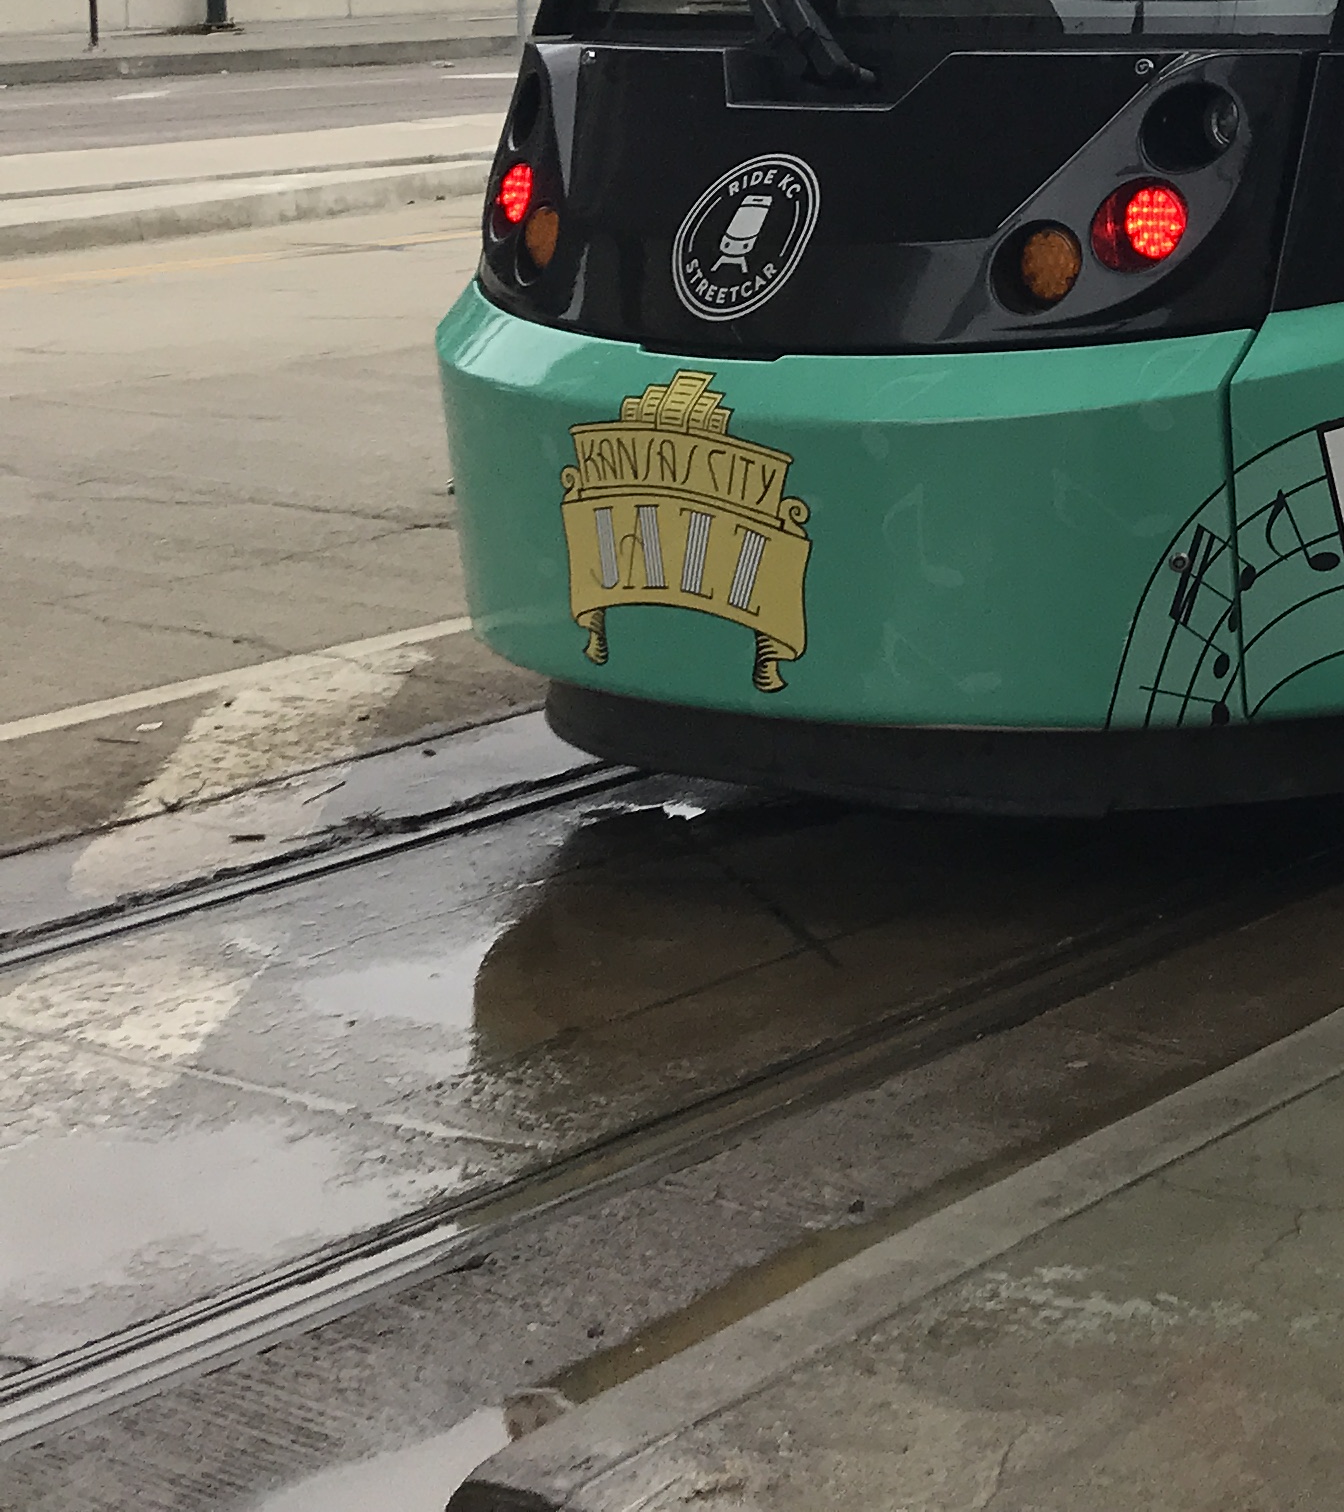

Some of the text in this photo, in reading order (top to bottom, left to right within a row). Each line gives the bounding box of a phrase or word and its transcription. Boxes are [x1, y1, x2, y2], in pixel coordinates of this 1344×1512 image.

[728, 169, 801, 199] RIDE KC
[686, 258, 777, 303] STREETCAR
[581, 437, 776, 505] KANSAS CITY
[590, 505, 772, 616] JAZZ
